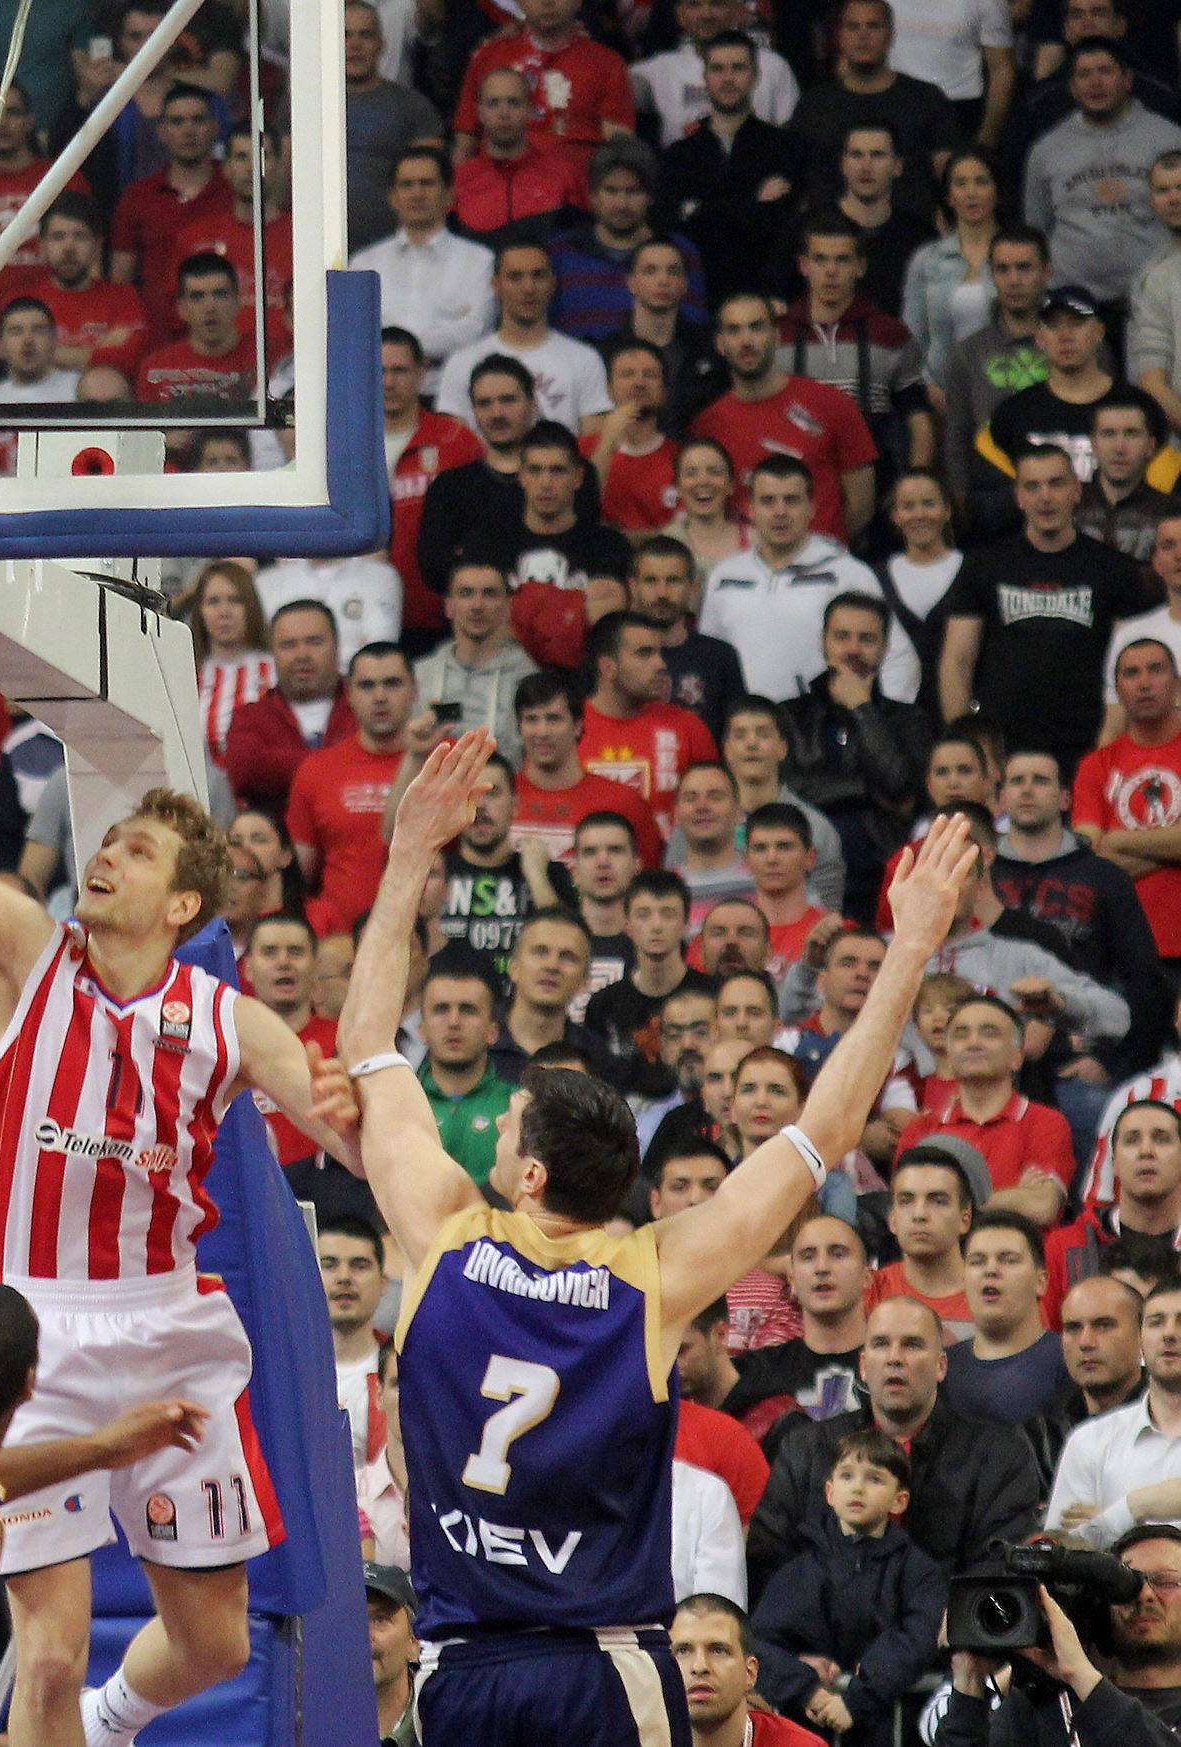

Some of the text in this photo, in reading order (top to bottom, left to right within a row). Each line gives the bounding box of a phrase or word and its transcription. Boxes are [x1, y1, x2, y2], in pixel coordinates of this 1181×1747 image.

[62, 1131, 136, 1162] Telekom
[460, 1355, 560, 1496] 7
[200, 1474, 252, 1541] 11
